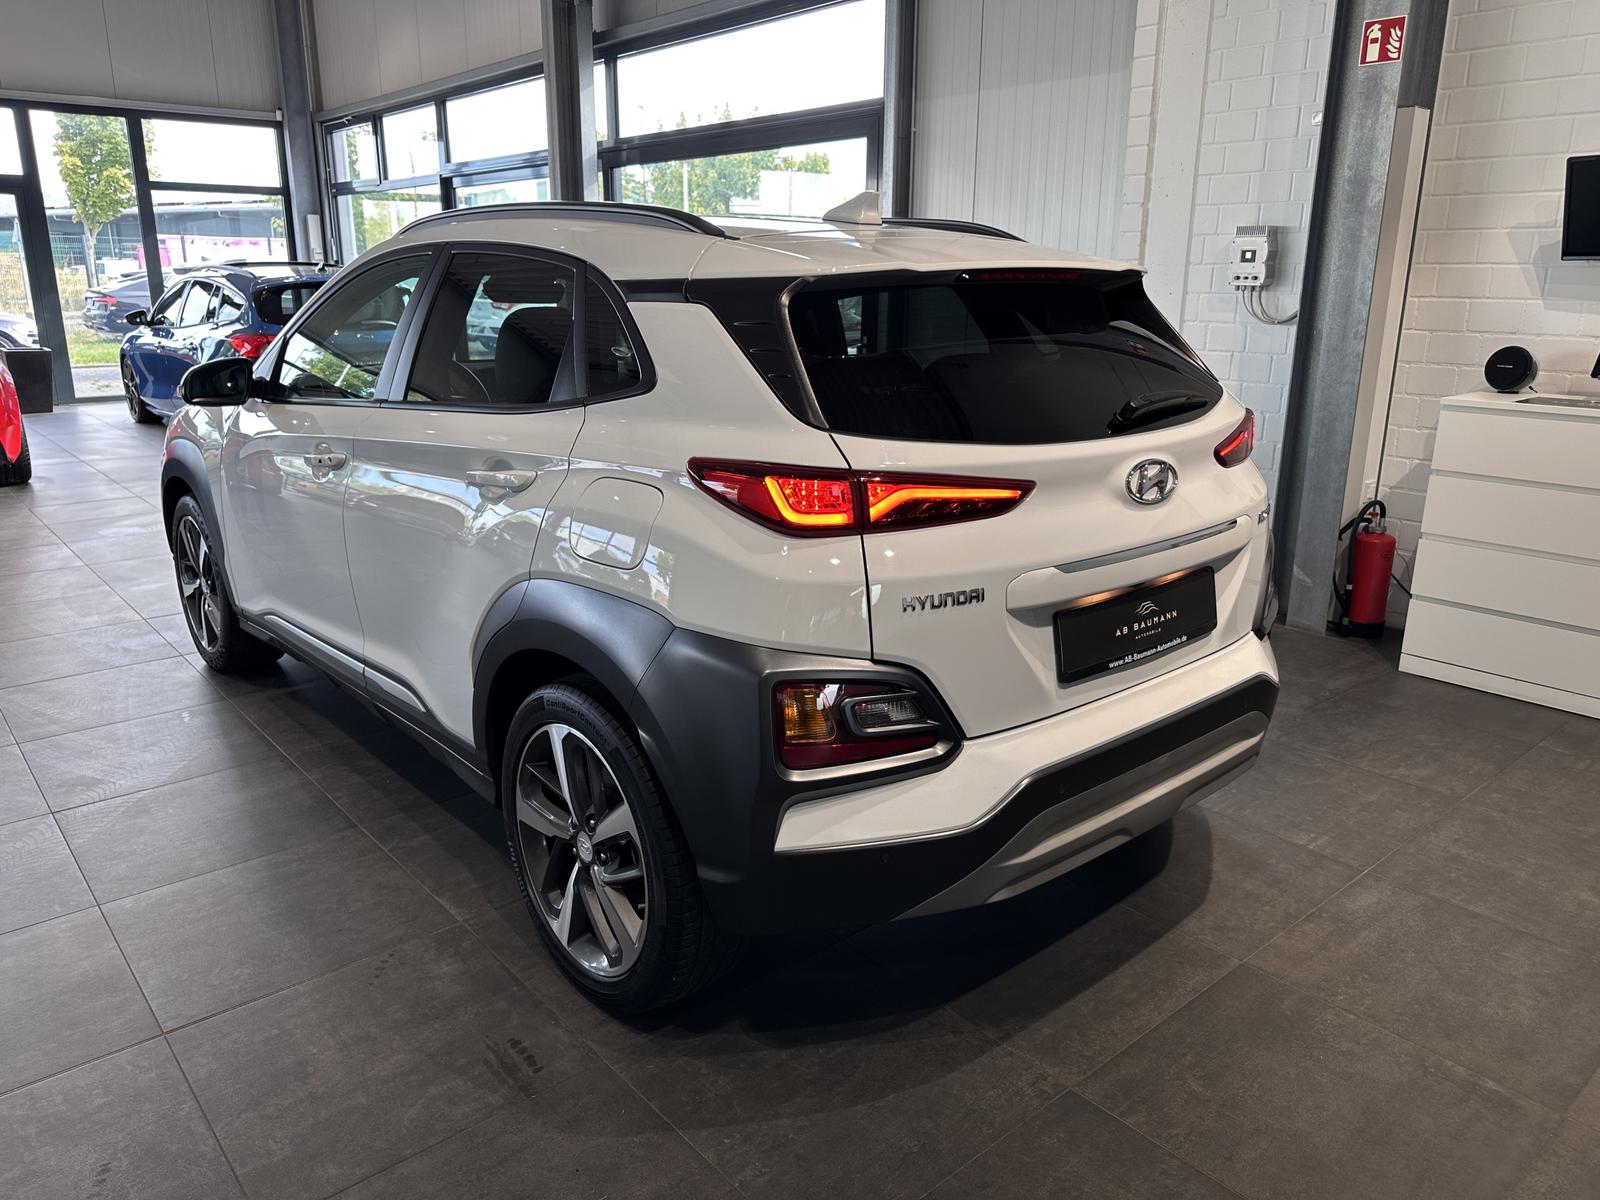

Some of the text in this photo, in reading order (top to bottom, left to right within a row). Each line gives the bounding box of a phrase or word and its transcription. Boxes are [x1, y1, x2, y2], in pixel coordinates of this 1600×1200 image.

[902, 587, 985, 613] HYUNDAI
[1115, 610, 1178, 637] AB BAUMANN
[1109, 635, 1187, 669] www.AB-Baumann-Automobile.de
